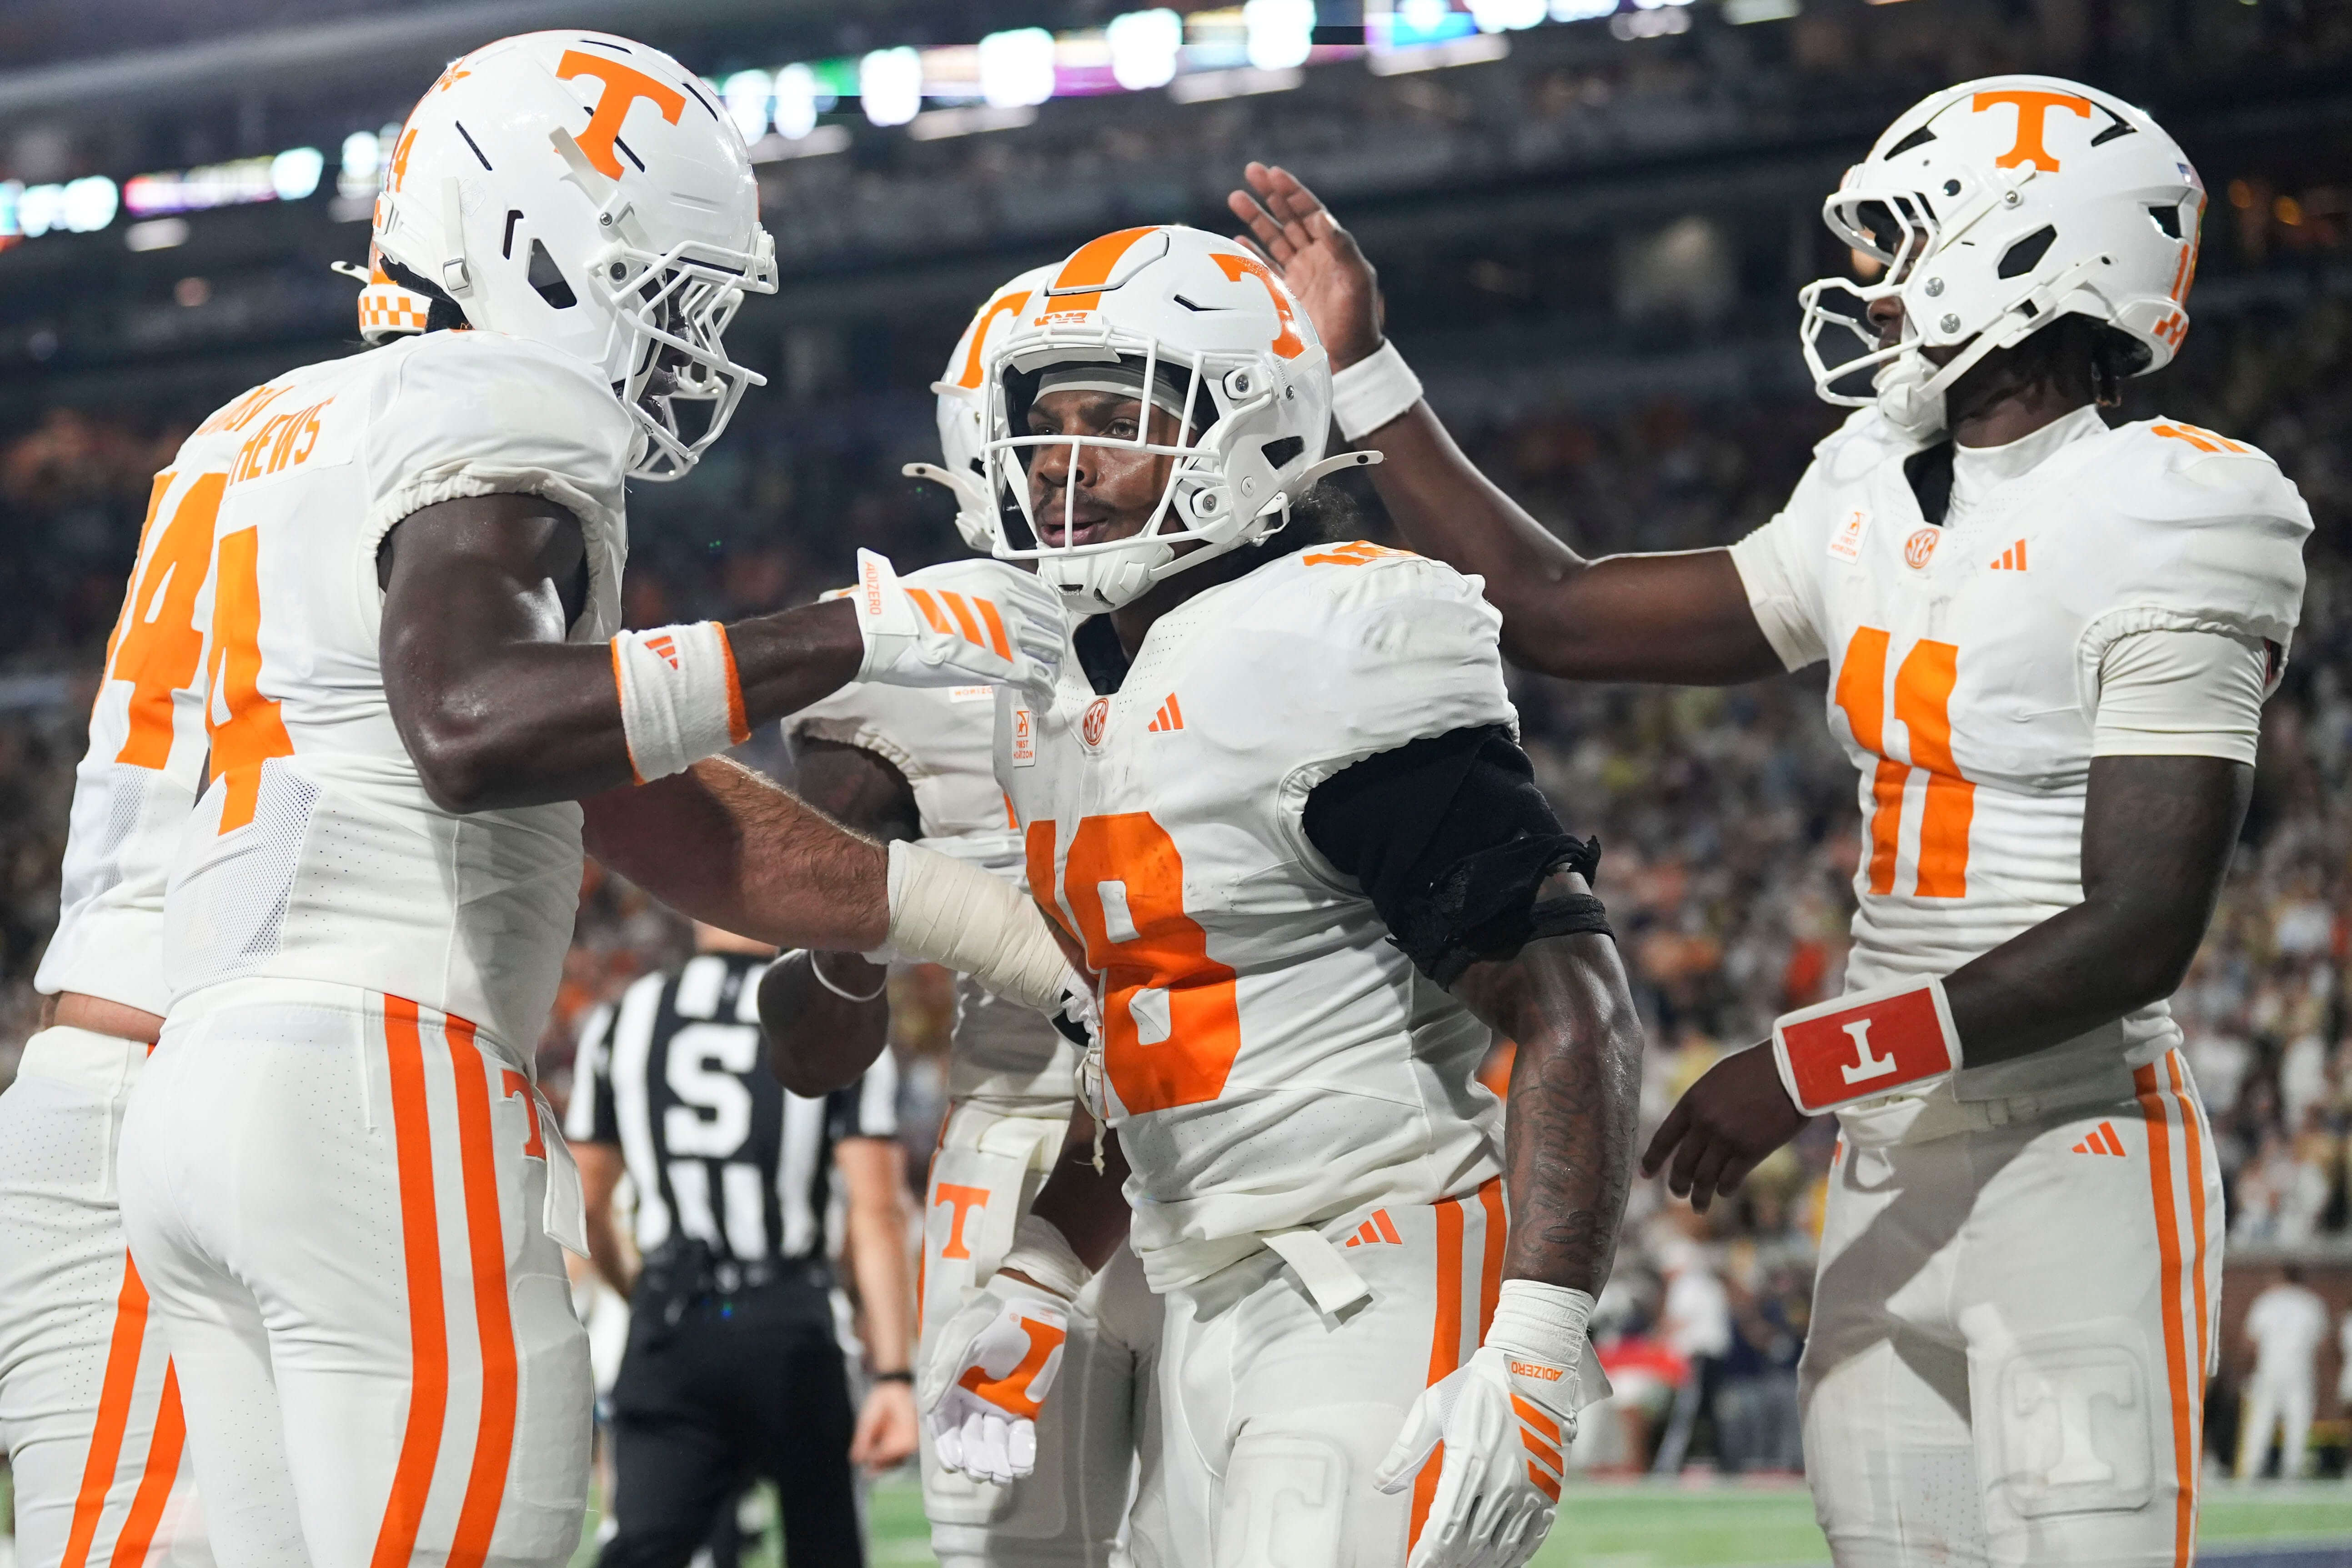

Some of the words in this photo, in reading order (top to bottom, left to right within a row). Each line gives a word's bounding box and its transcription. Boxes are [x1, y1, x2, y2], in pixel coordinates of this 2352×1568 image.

[556, 49, 687, 181] T
[1972, 90, 2092, 173] T
[393, 128, 418, 193] 4
[1907, 529, 1937, 566] SEC
[865, 561, 882, 615] ADIZERO
[205, 525, 295, 837] 4
[1013, 750, 1033, 759] HORIZON
[1016, 740, 1029, 749] FIRST
[1084, 700, 1107, 743] SEC
[1835, 625, 1976, 899] 11
[1840, 1018, 1897, 1085] T
[664, 1024, 762, 1156] S
[935, 1182, 991, 1260] T
[1511, 1361, 1563, 1381] ADIZERO
